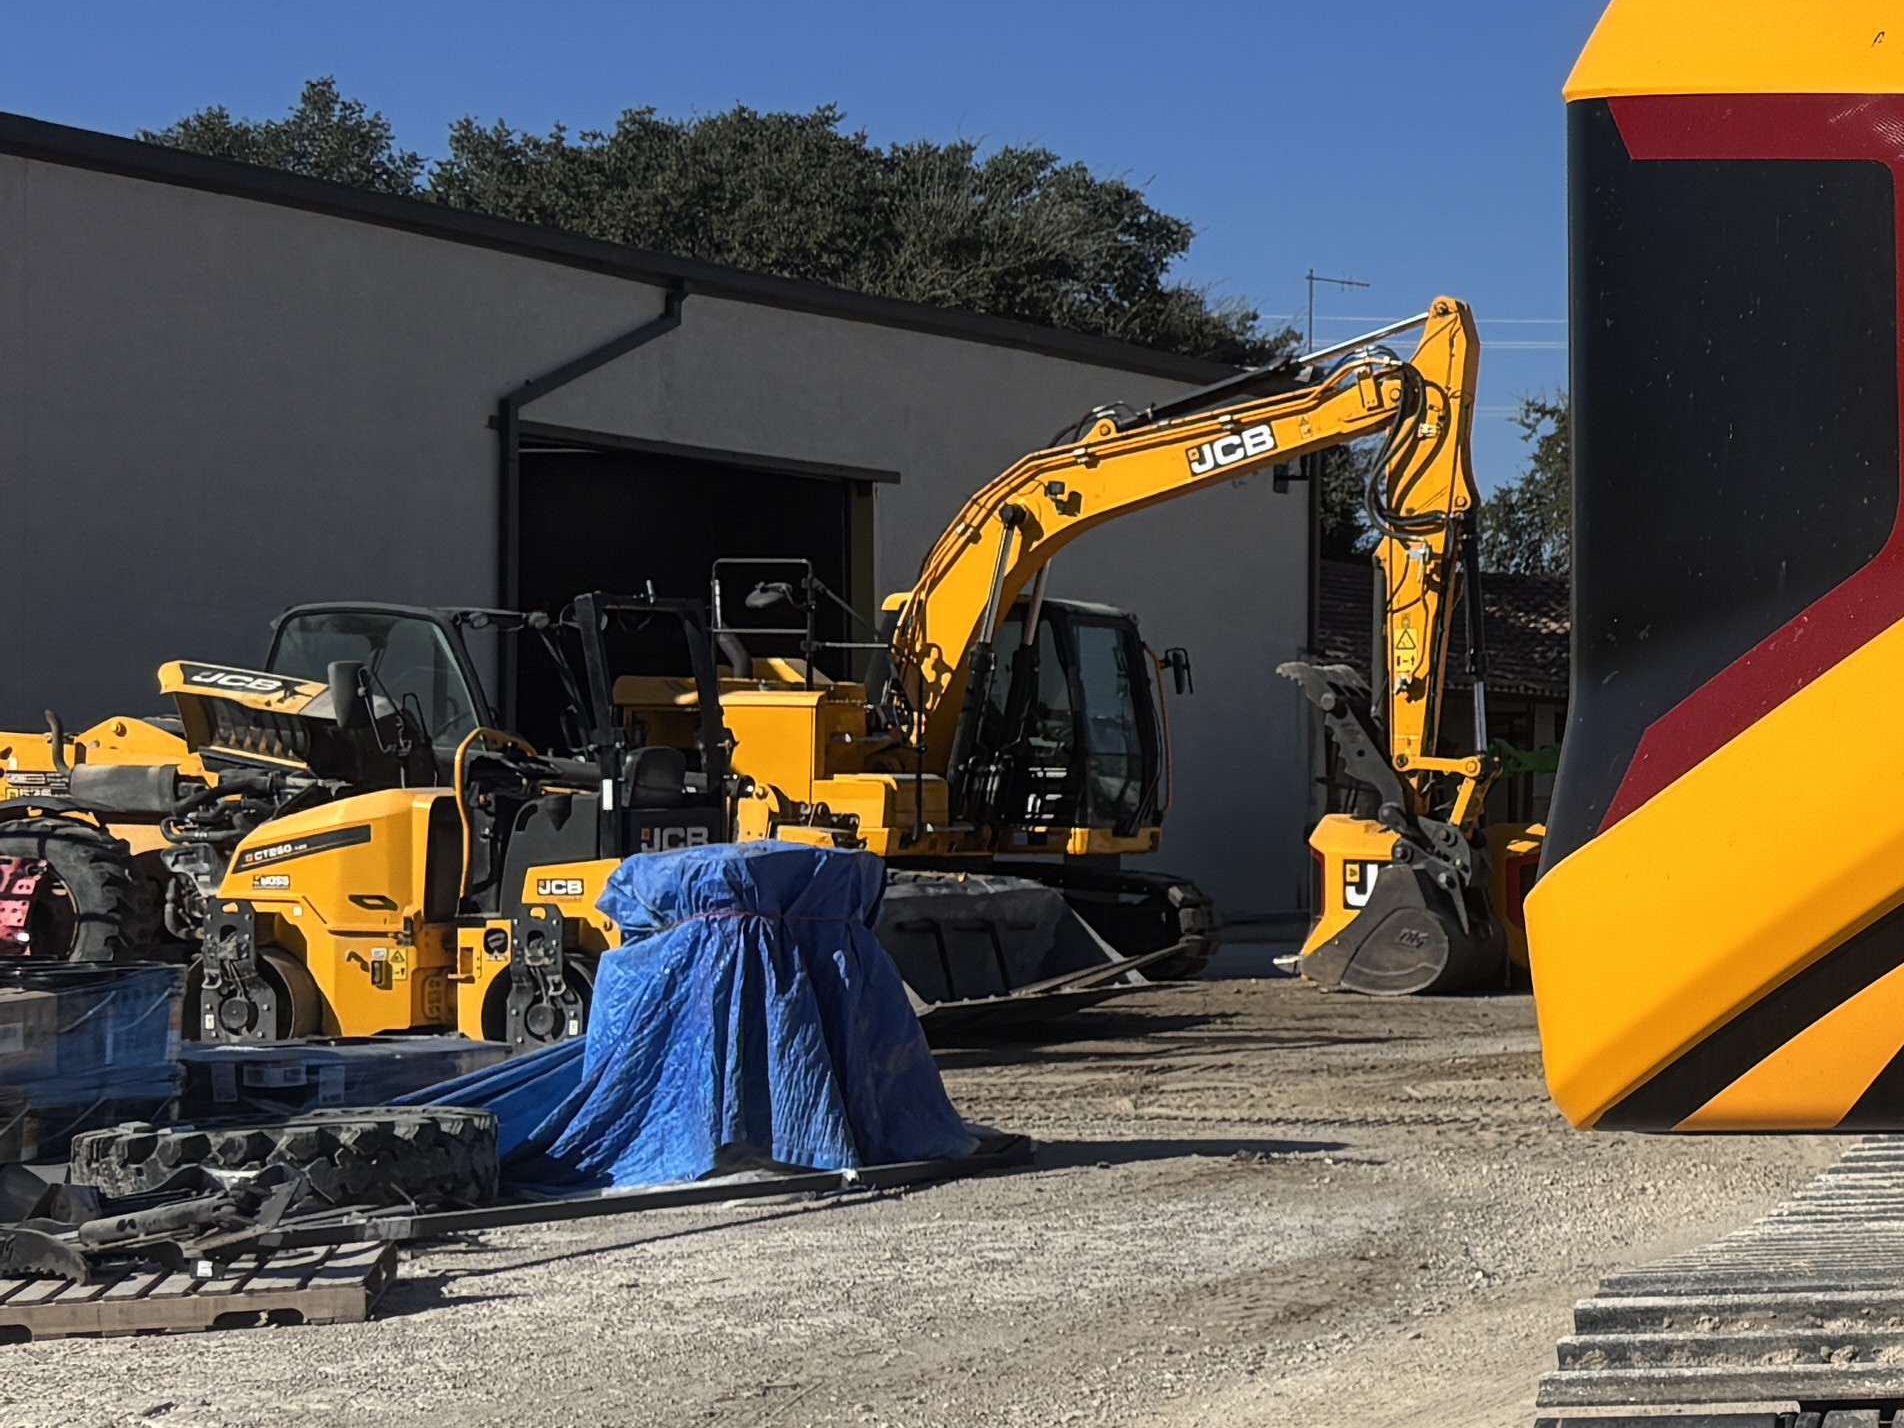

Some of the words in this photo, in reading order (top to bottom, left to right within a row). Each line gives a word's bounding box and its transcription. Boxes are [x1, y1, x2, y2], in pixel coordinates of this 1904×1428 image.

[1190, 424, 1276, 474] JCB
[191, 672, 283, 692] JCB
[640, 827, 710, 853] JCB
[537, 879, 583, 895] JCB
